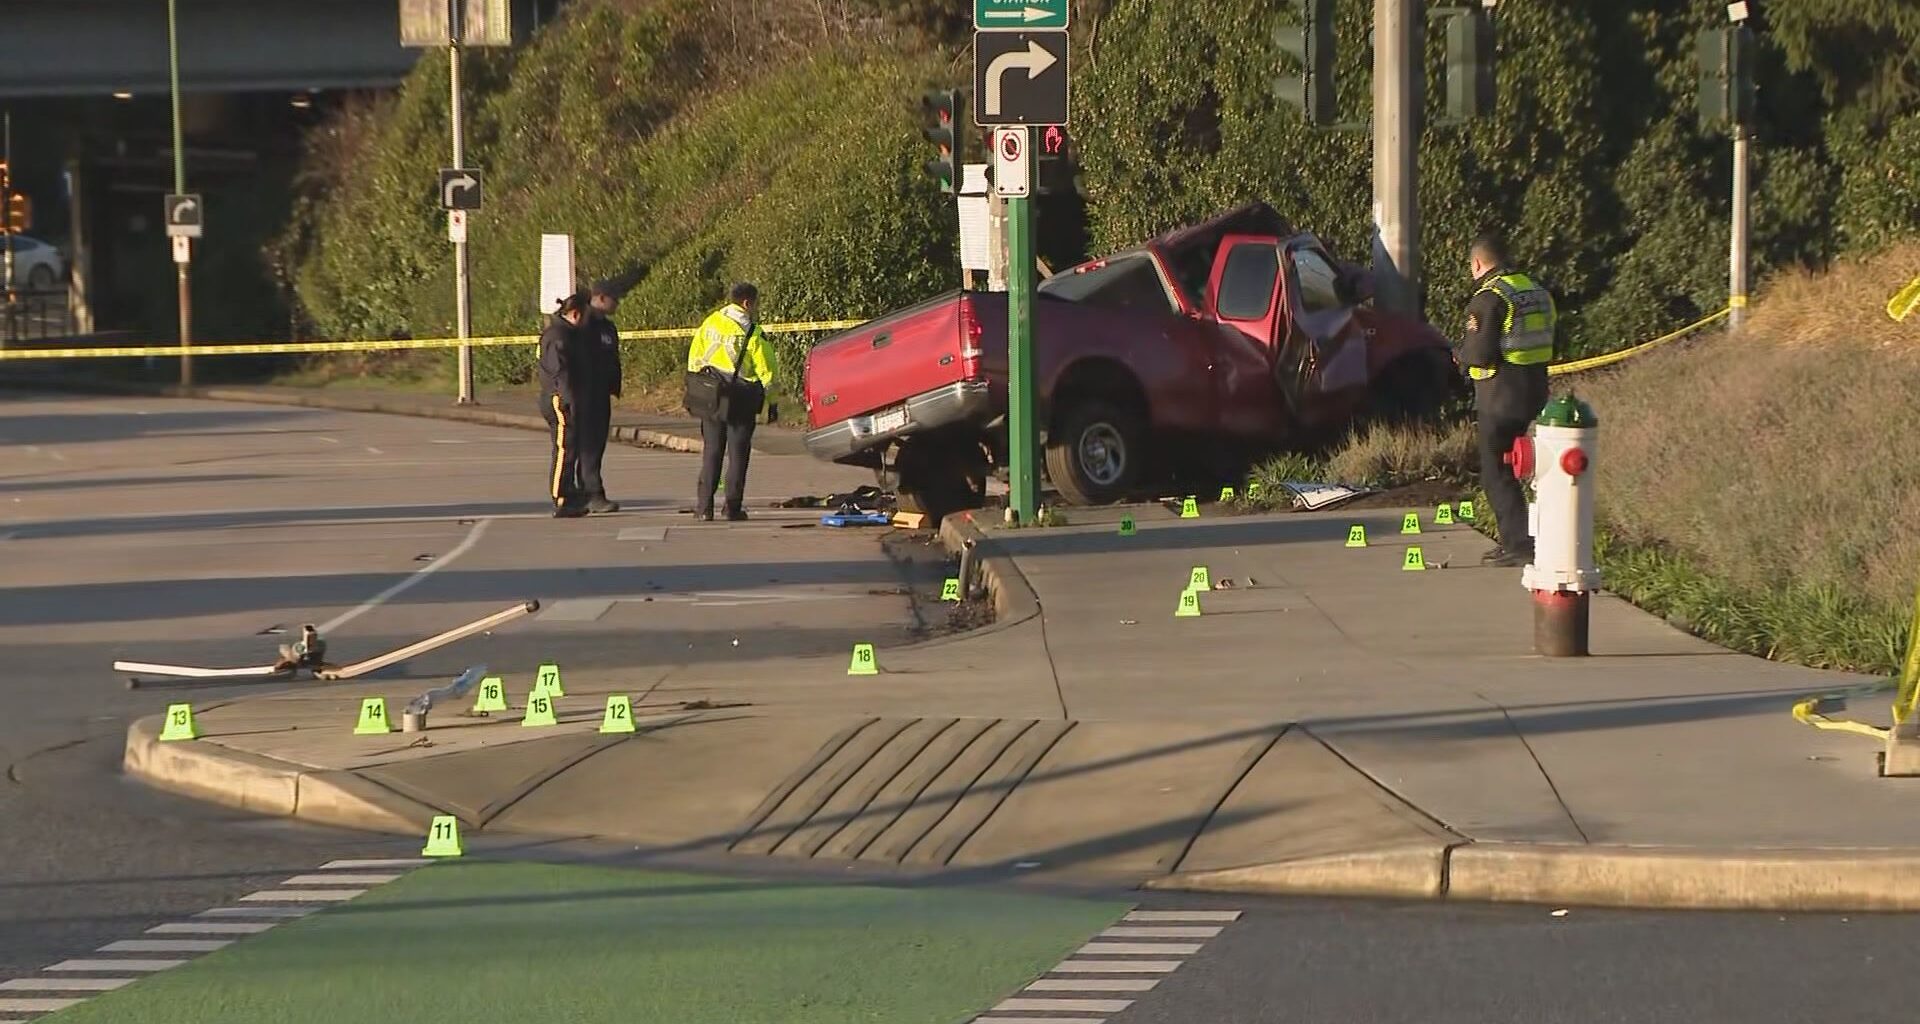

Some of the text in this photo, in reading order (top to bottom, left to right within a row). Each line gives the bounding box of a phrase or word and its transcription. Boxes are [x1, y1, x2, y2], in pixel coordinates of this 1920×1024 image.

[1185, 504, 1194, 513] 31
[1439, 508, 1449, 518] 25
[1406, 518, 1416, 528] 24
[1351, 531, 1362, 541] 23
[1408, 552, 1419, 563] 21
[1193, 572, 1205, 583] 20
[946, 584, 956, 594] 22
[1183, 595, 1195, 606] 19
[857, 649, 870, 662] 18
[541, 673, 555, 686] 17
[484, 685, 498, 699] 16
[368, 704, 382, 719] 14
[531, 698, 547, 713] 15
[609, 704, 625, 719] 12
[173, 711, 187, 725] 13
[435, 823, 451, 839] 11
